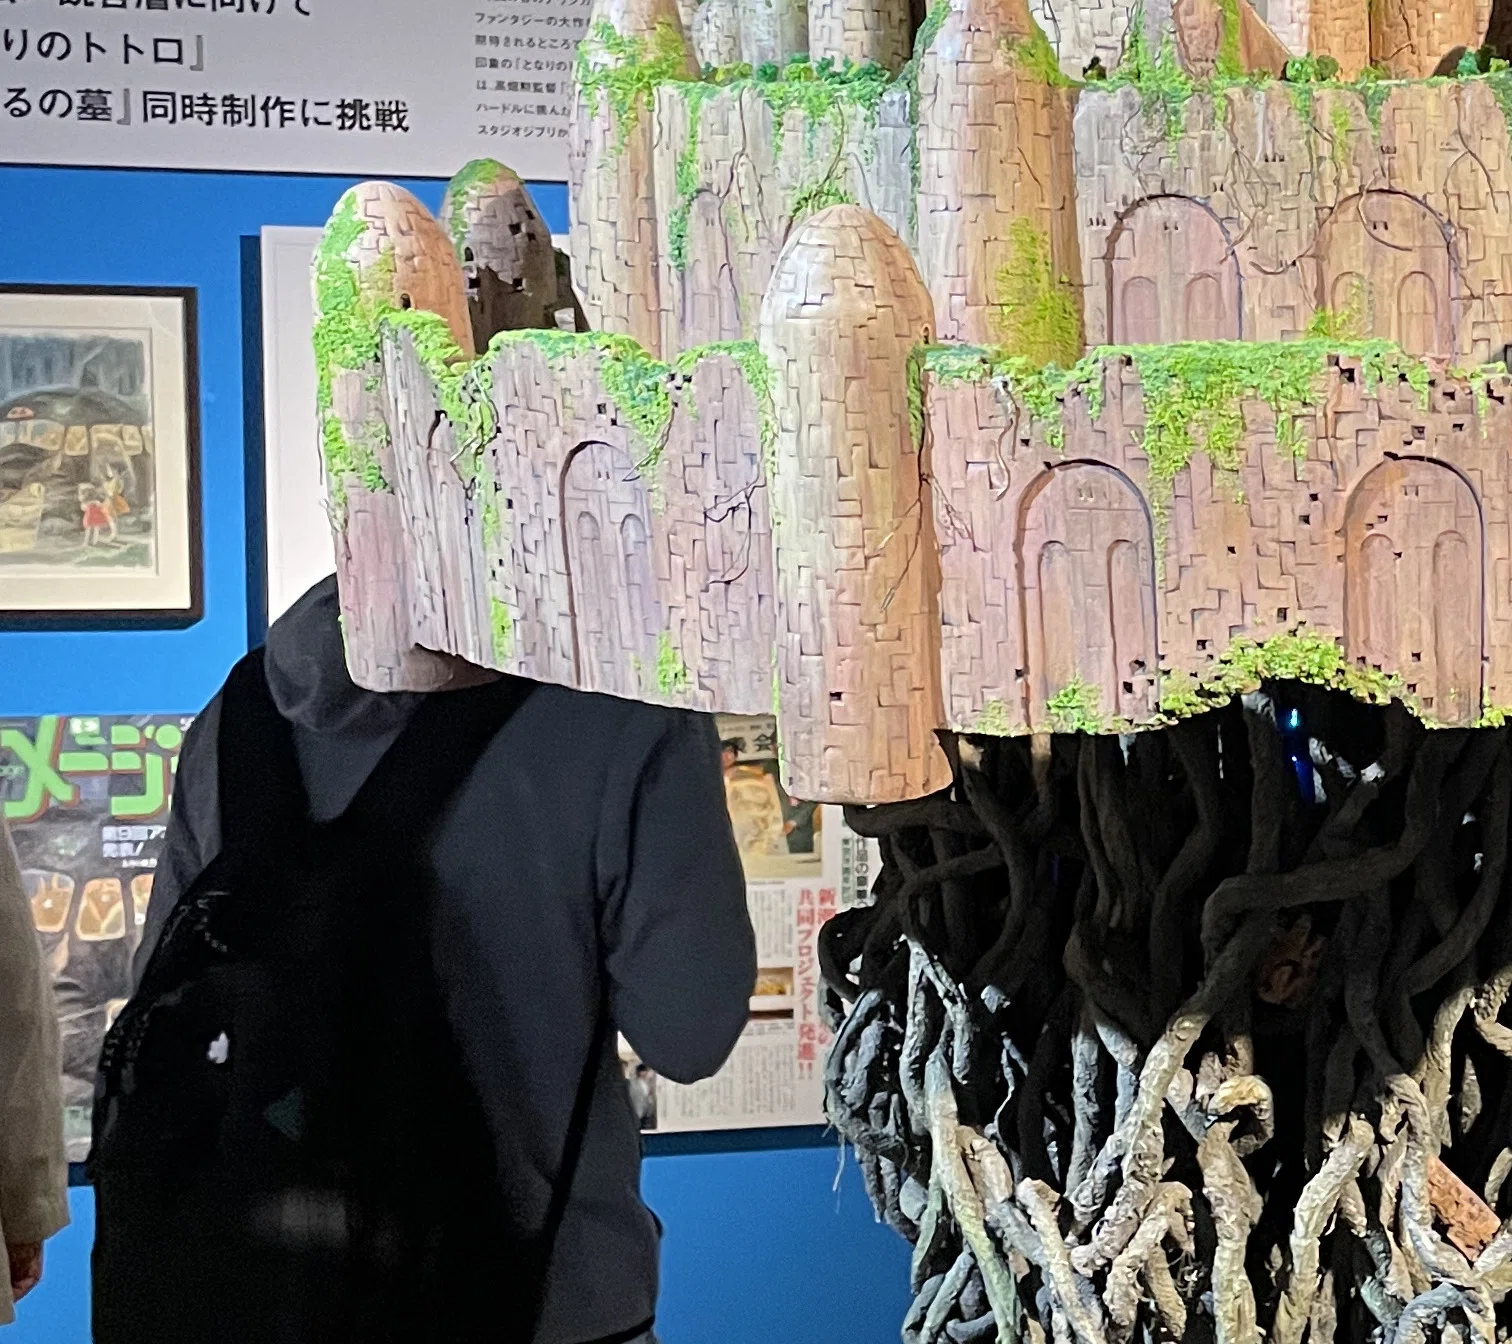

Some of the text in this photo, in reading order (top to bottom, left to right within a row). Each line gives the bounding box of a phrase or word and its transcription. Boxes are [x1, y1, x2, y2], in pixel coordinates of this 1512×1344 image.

[3, 28, 205, 72] りのトトロ』
[3, 86, 410, 133] るの墓』同時制作に挑戦
[0, 714, 182, 817] メージ
